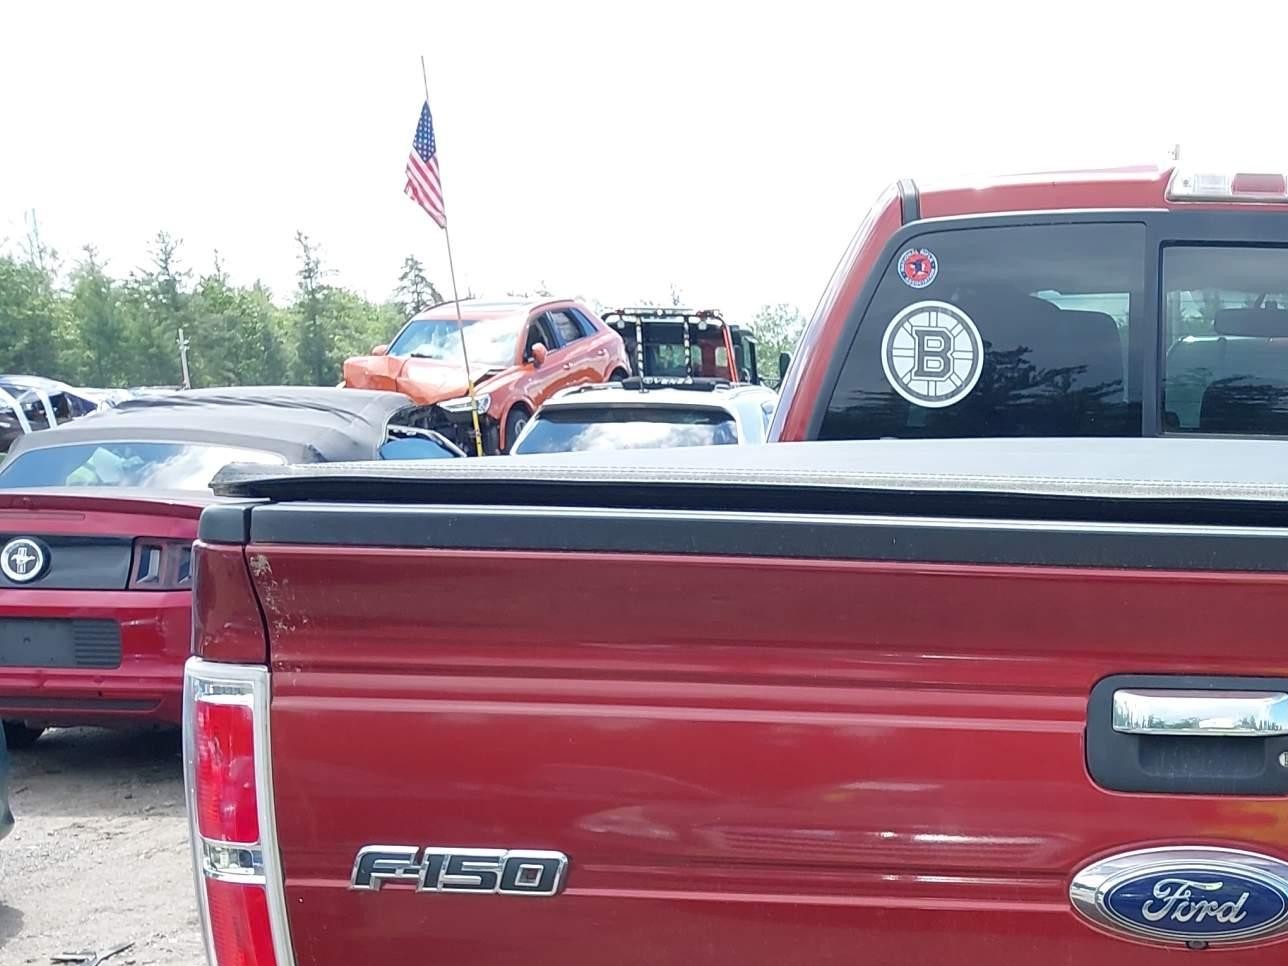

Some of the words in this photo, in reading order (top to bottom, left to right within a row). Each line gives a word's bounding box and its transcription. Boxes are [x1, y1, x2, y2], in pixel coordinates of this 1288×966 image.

[911, 327, 953, 380] B
[350, 845, 568, 896] F-150
[1141, 878, 1250, 924] Ford
